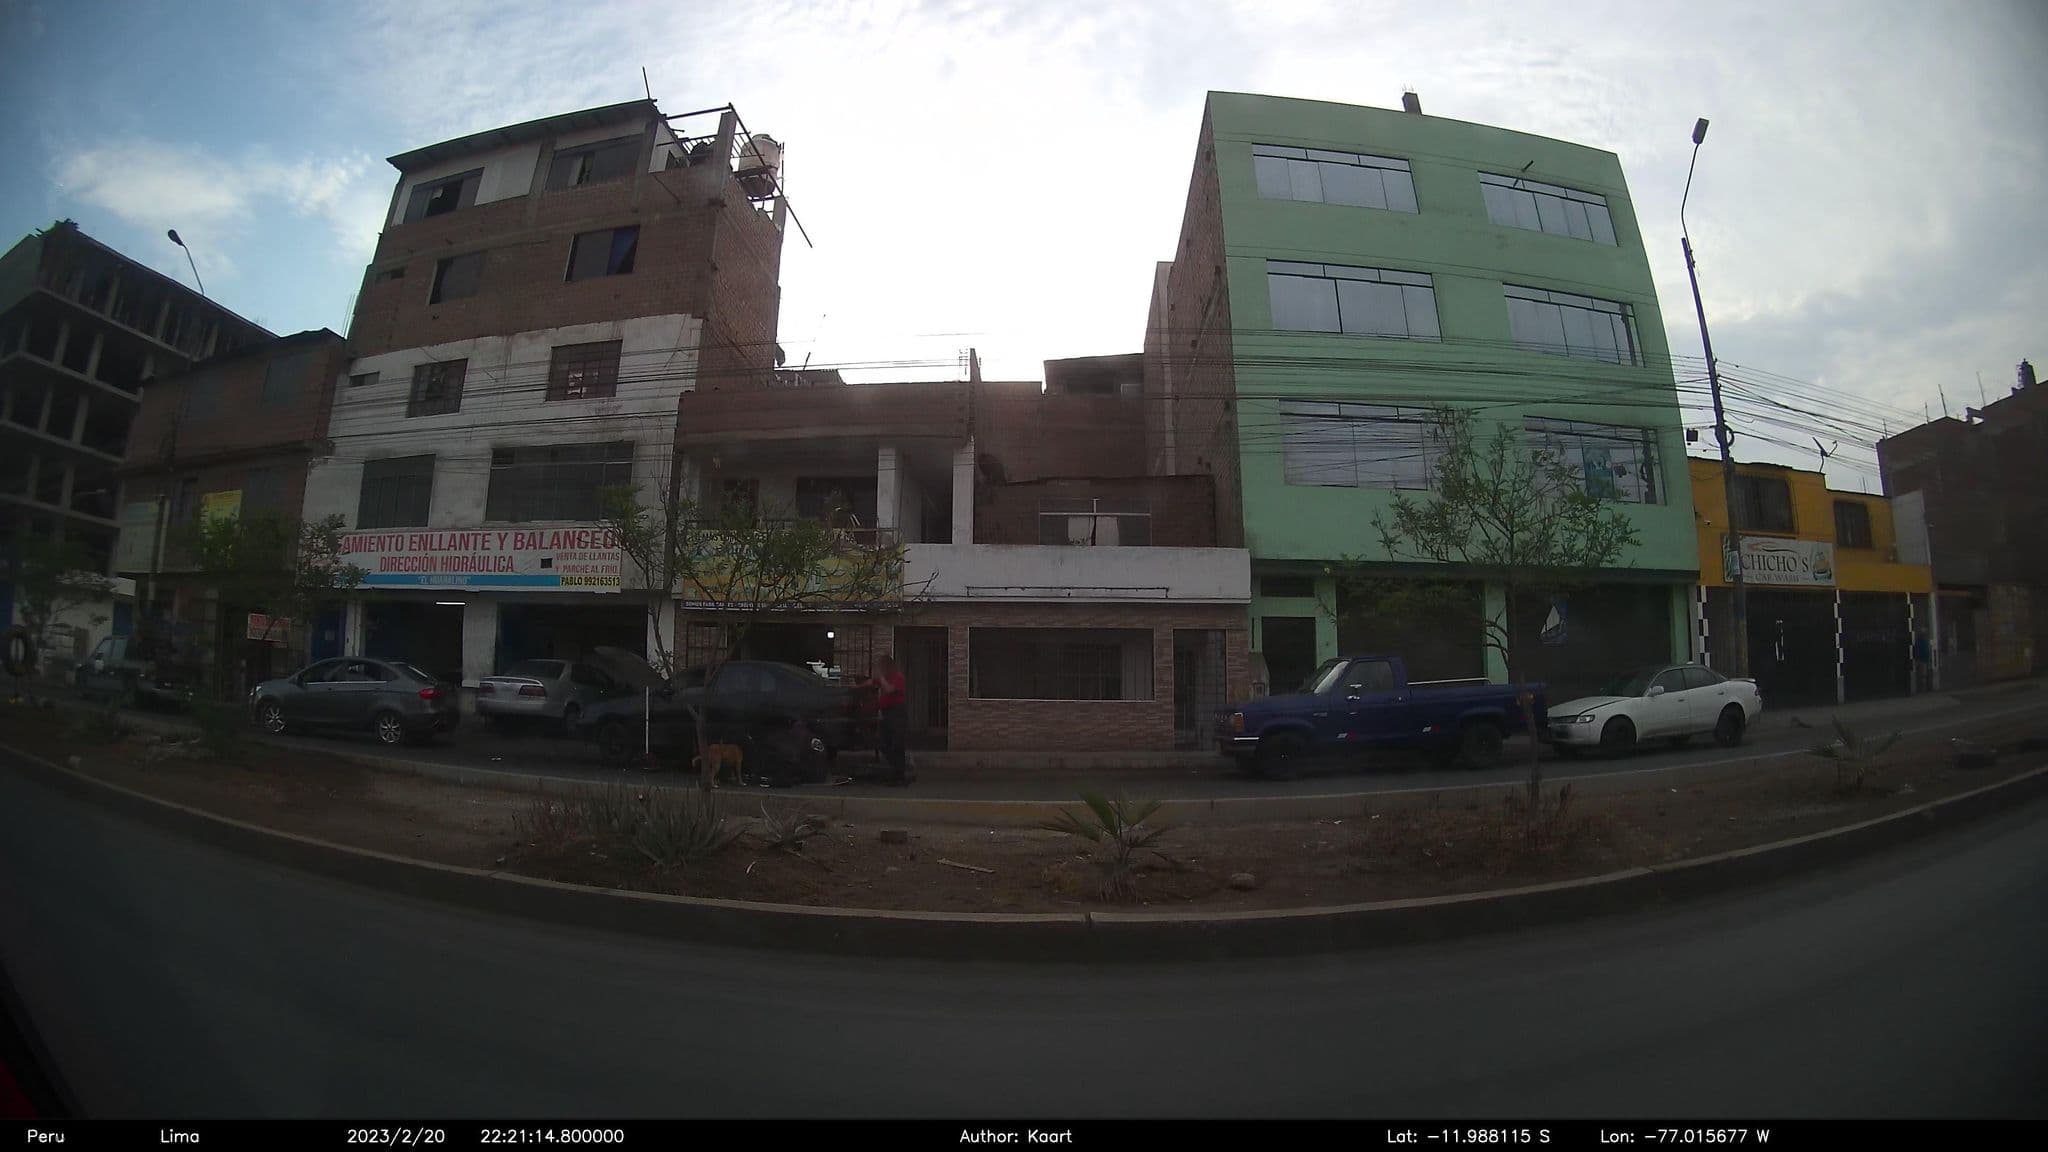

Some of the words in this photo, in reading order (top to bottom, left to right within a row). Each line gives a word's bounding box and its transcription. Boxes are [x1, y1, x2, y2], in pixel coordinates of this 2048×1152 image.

[408, 531, 491, 552] ENLLANTE
[497, 532, 508, 550] Y
[513, 530, 615, 551] BALANCEO
[556, 553, 576, 561] VENTA
[578, 553, 589, 561] DE
[589, 552, 620, 561] LLANTAS
[380, 553, 437, 572] DIRECCIÓN
[441, 552, 514, 573] HIDRÁULICA
[590, 565, 598, 573] AL
[561, 576, 583, 586] PABLO
